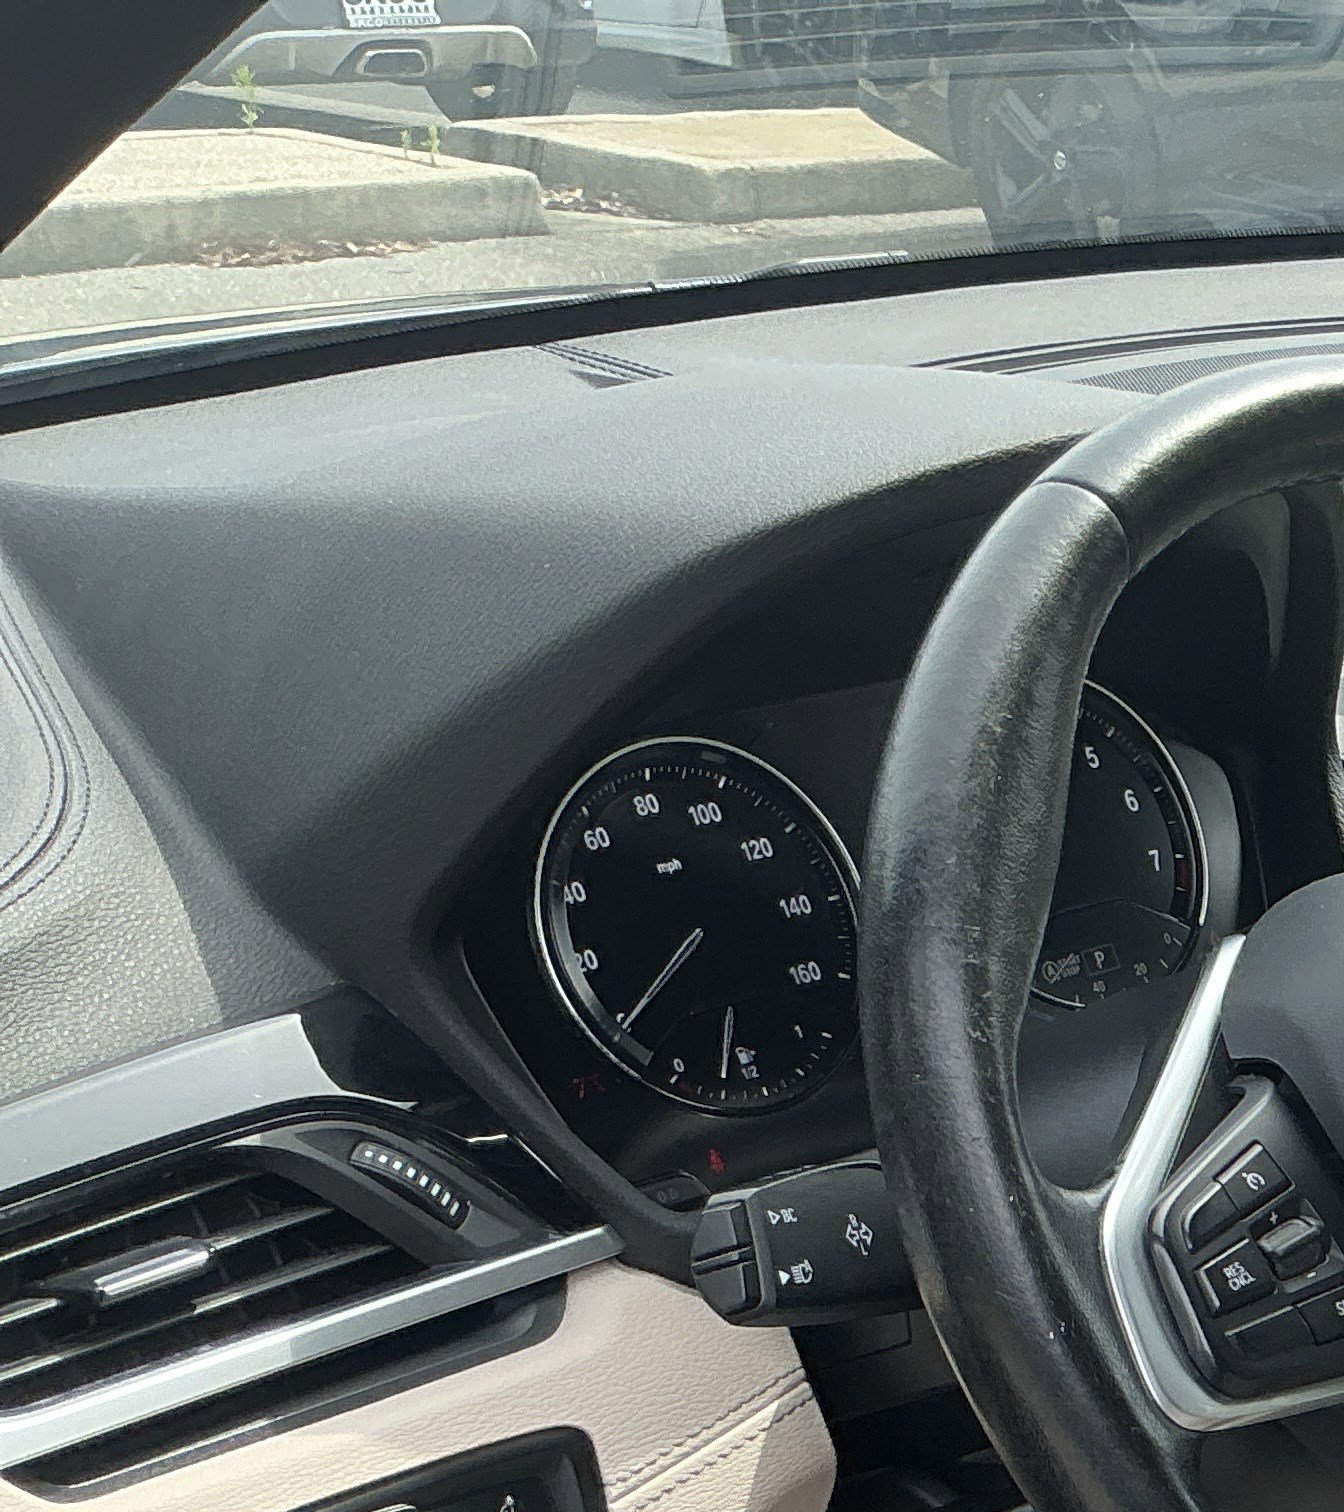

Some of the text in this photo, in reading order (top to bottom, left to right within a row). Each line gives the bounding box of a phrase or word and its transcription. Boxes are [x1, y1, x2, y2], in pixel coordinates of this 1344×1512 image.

[1084, 746, 1100, 769] 5
[632, 793, 723, 826] 80 100
[1124, 788, 1140, 812] 6
[583, 826, 611, 851] 60
[740, 837, 774, 861] 120
[656, 858, 683, 875] mph
[1148, 849, 1161, 872] 7
[563, 881, 587, 905] 40
[779, 894, 813, 919] 140
[1093, 950, 1105, 970] P
[788, 961, 822, 985] 160
[794, 1024, 803, 1038] 1
[672, 1057, 685, 1073] 0
[780, 1207, 798, 1224] BC
[1222, 1260, 1246, 1279] RES
